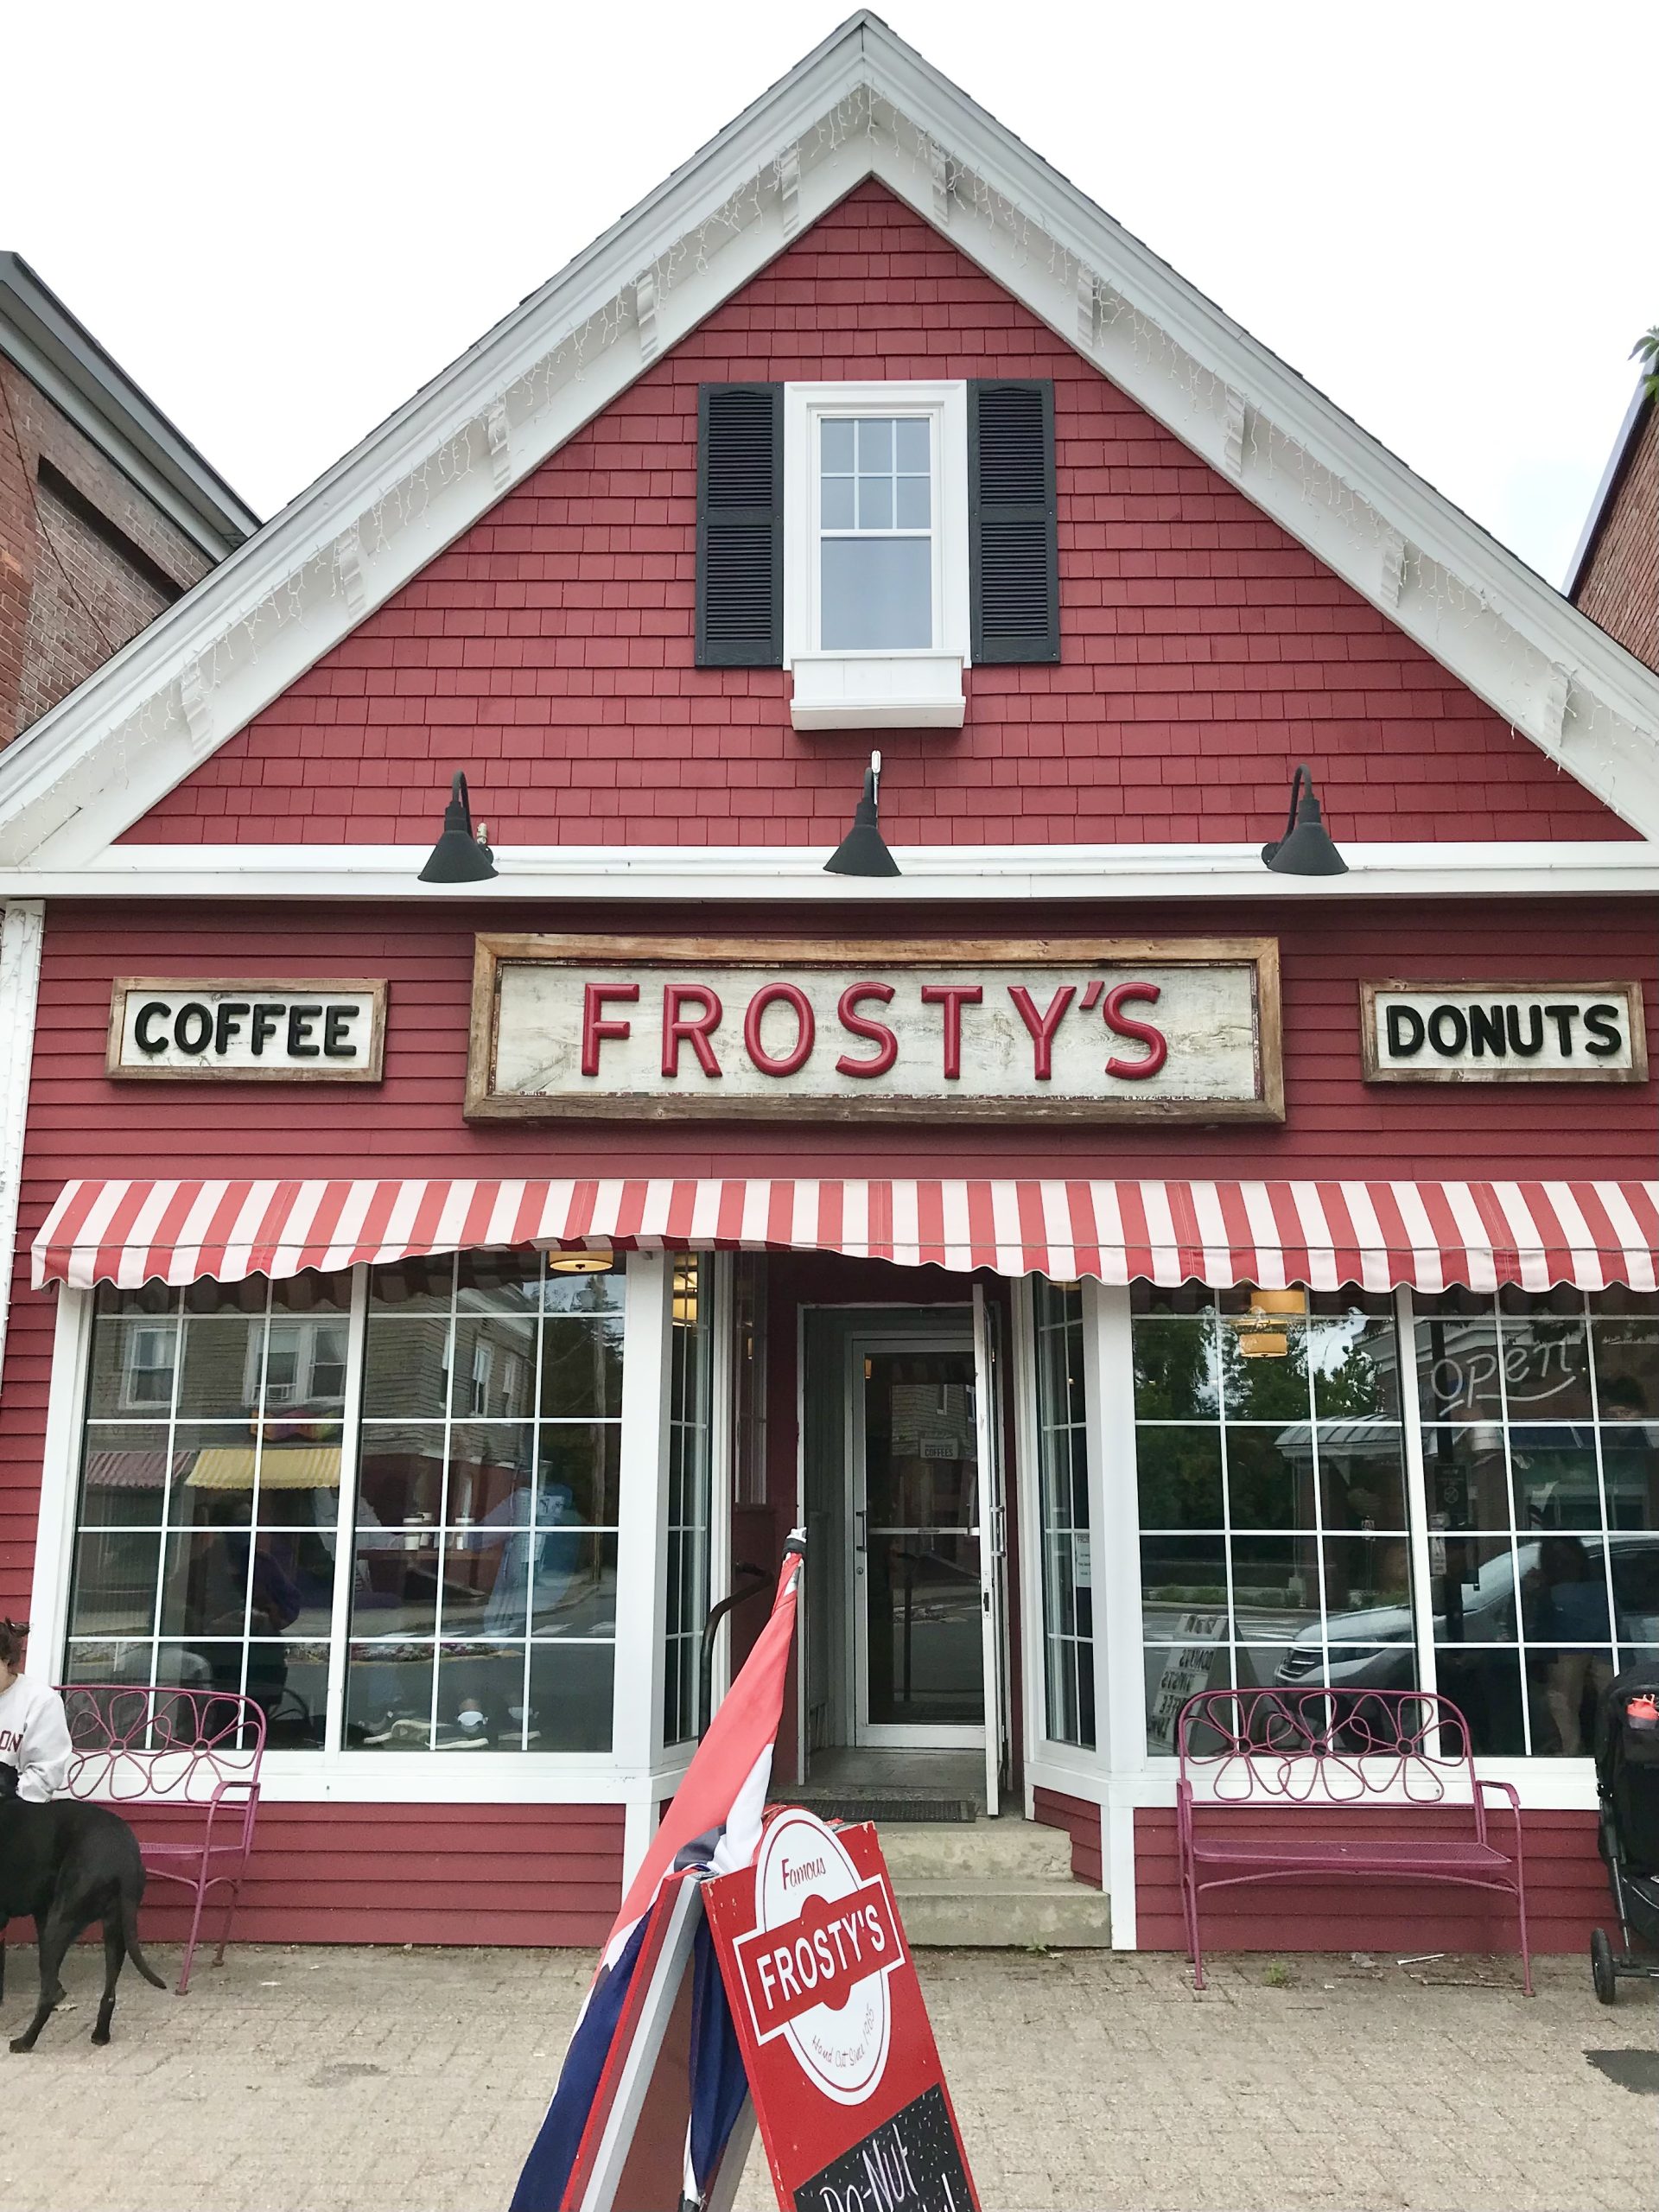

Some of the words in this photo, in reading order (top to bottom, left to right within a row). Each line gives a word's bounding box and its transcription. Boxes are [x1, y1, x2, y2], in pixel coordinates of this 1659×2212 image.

[134, 1001, 360, 1058] COFFEE
[581, 981, 1168, 1081] FROSTY'S
[1385, 1003, 1623, 1058] DONUTS
[925, 1448, 953, 1458] COFFEES
[781, 1857, 826, 1891] Famous
[756, 1904, 886, 2012] FROSTY'S
[812, 2034, 834, 2063] Hand
